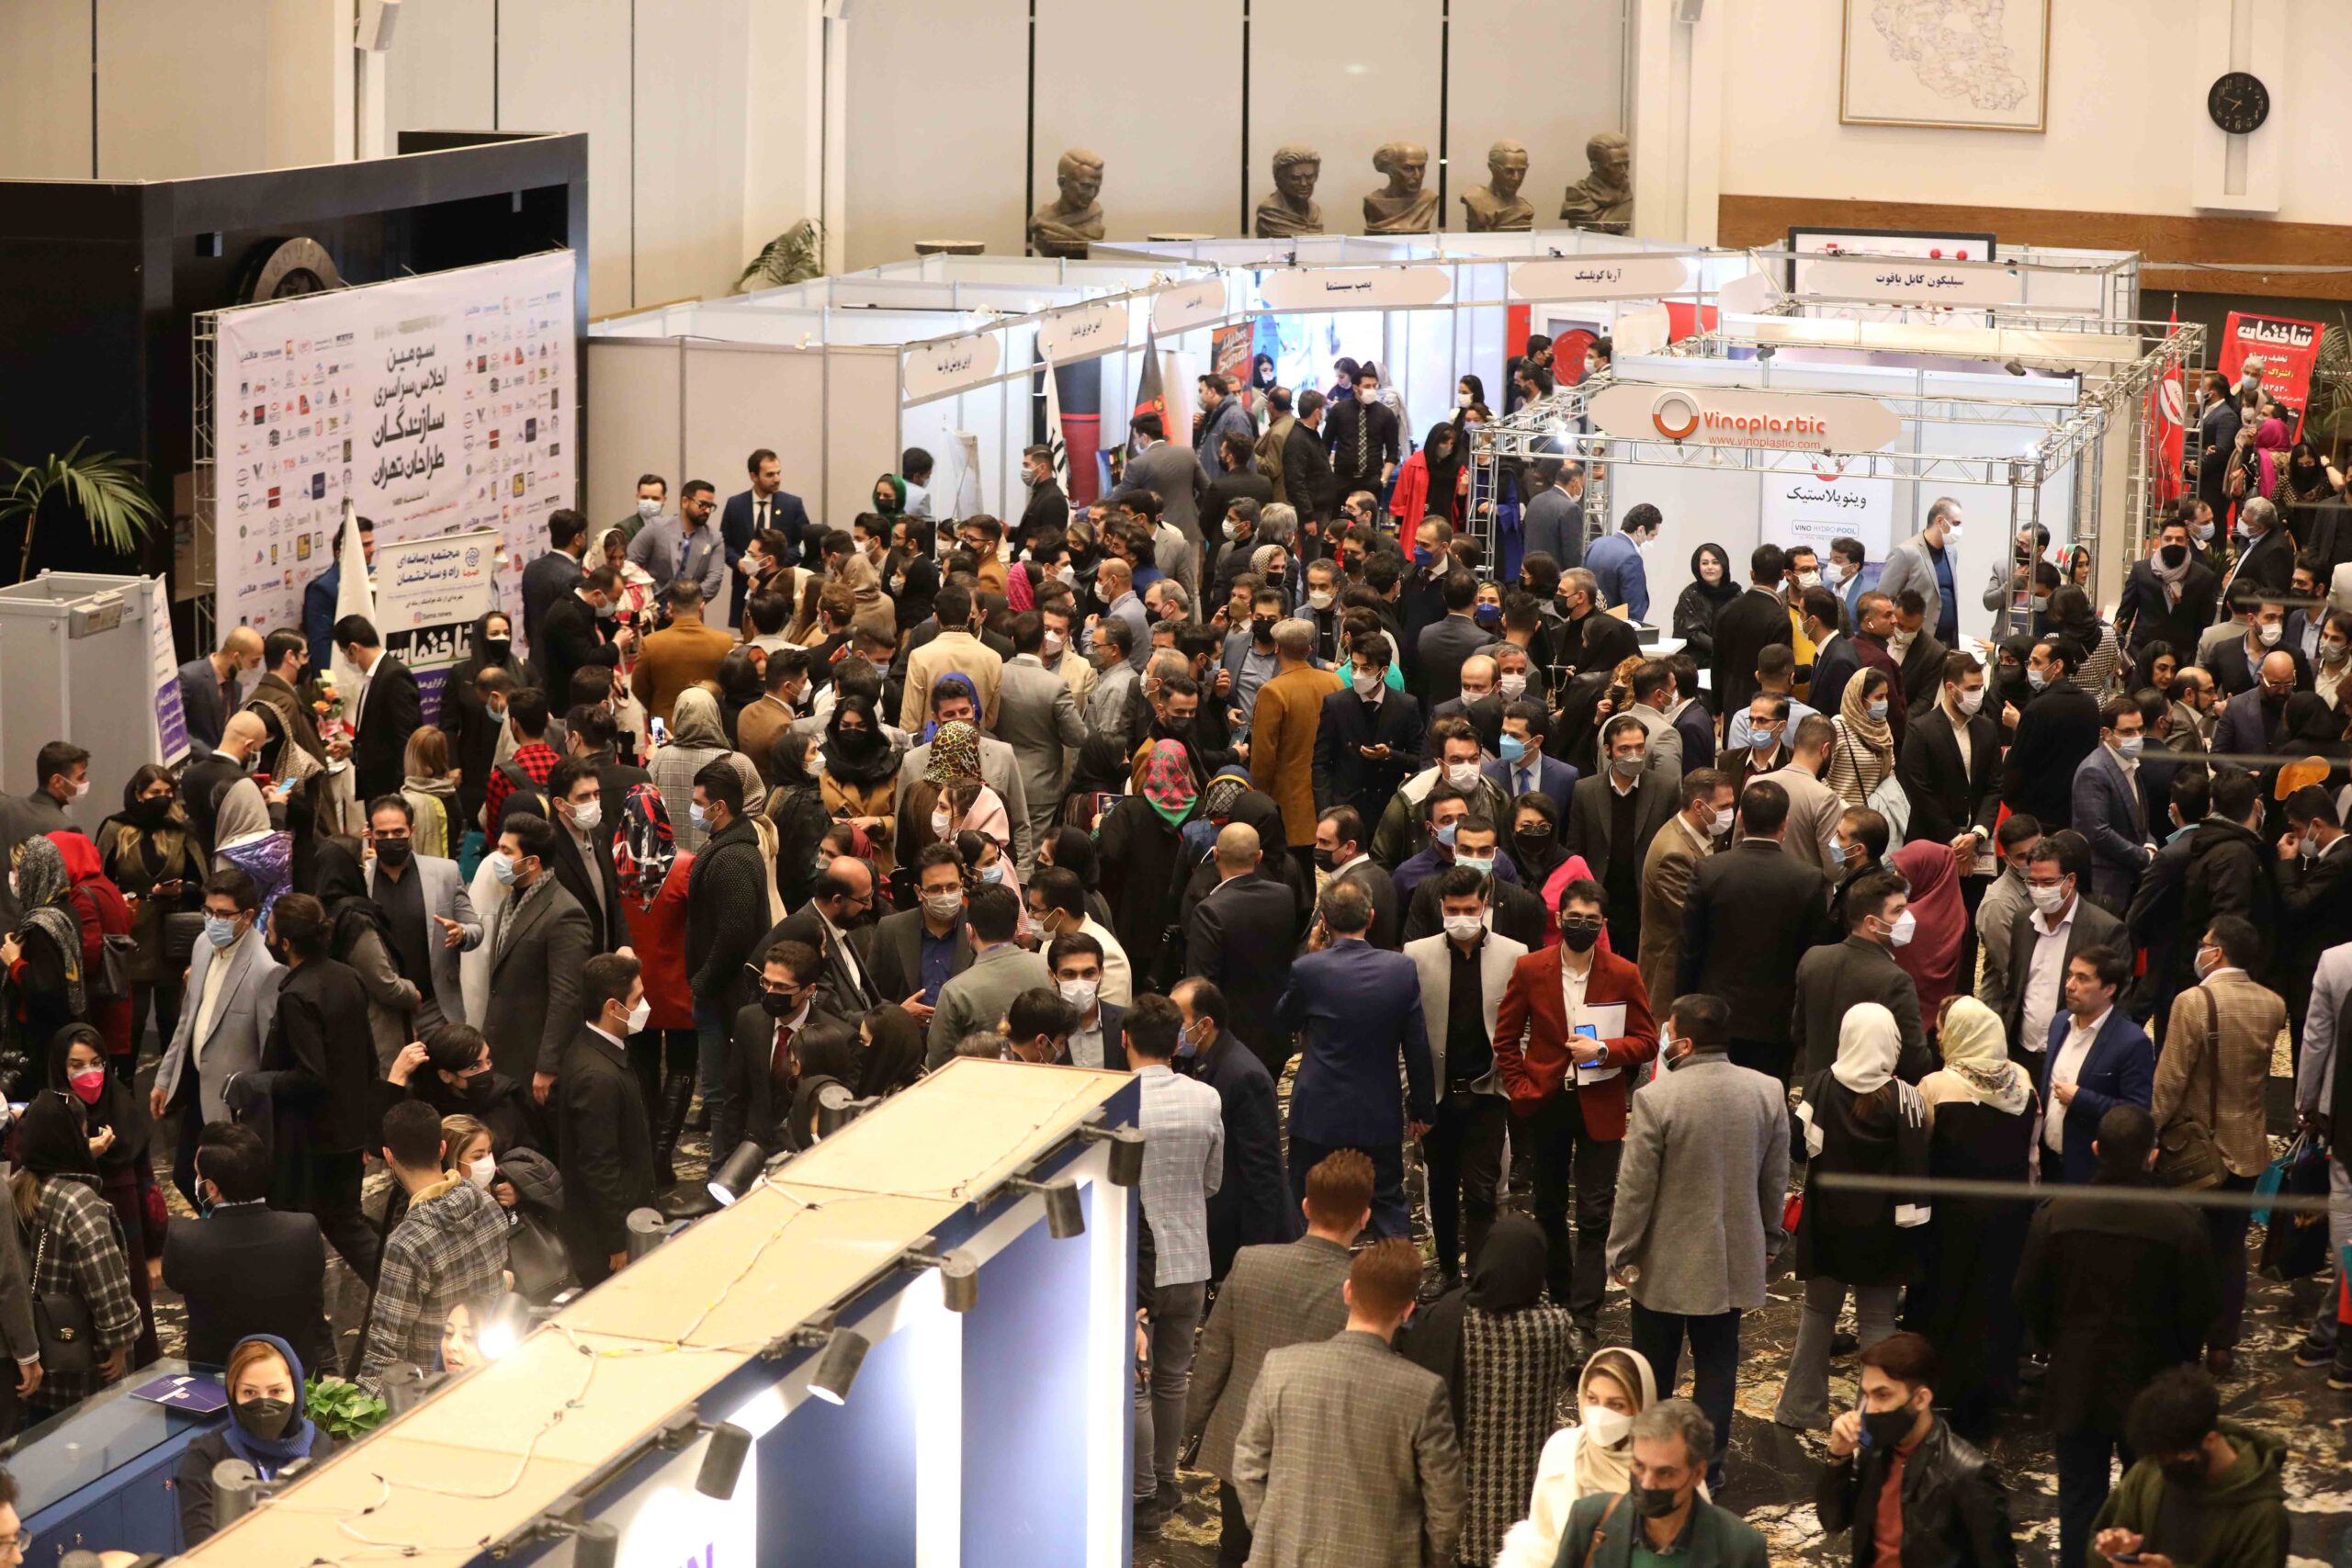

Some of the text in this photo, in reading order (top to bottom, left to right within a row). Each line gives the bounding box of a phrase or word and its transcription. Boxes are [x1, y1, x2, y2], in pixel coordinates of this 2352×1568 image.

[1607, 268, 1622, 283] آریا
[1876, 273, 1963, 288] سیلیکون کابل یاقوت
[2237, 320, 2312, 347] ساختمان
[387, 344, 435, 373] سومین
[374, 366, 447, 408] اجلاس سراسری
[372, 403, 445, 448] سازندگان
[1703, 411, 1826, 435] Vinoplastic
[1709, 435, 1821, 449] www.vinoplastic.com
[372, 445, 445, 490] طراحان تهران
[1787, 487, 1867, 509] وینوپلاستیک
[1837, 526, 1856, 535] POOL
[430, 548, 460, 565] مجتمع
[397, 566, 459, 586] راه و ساختمان
